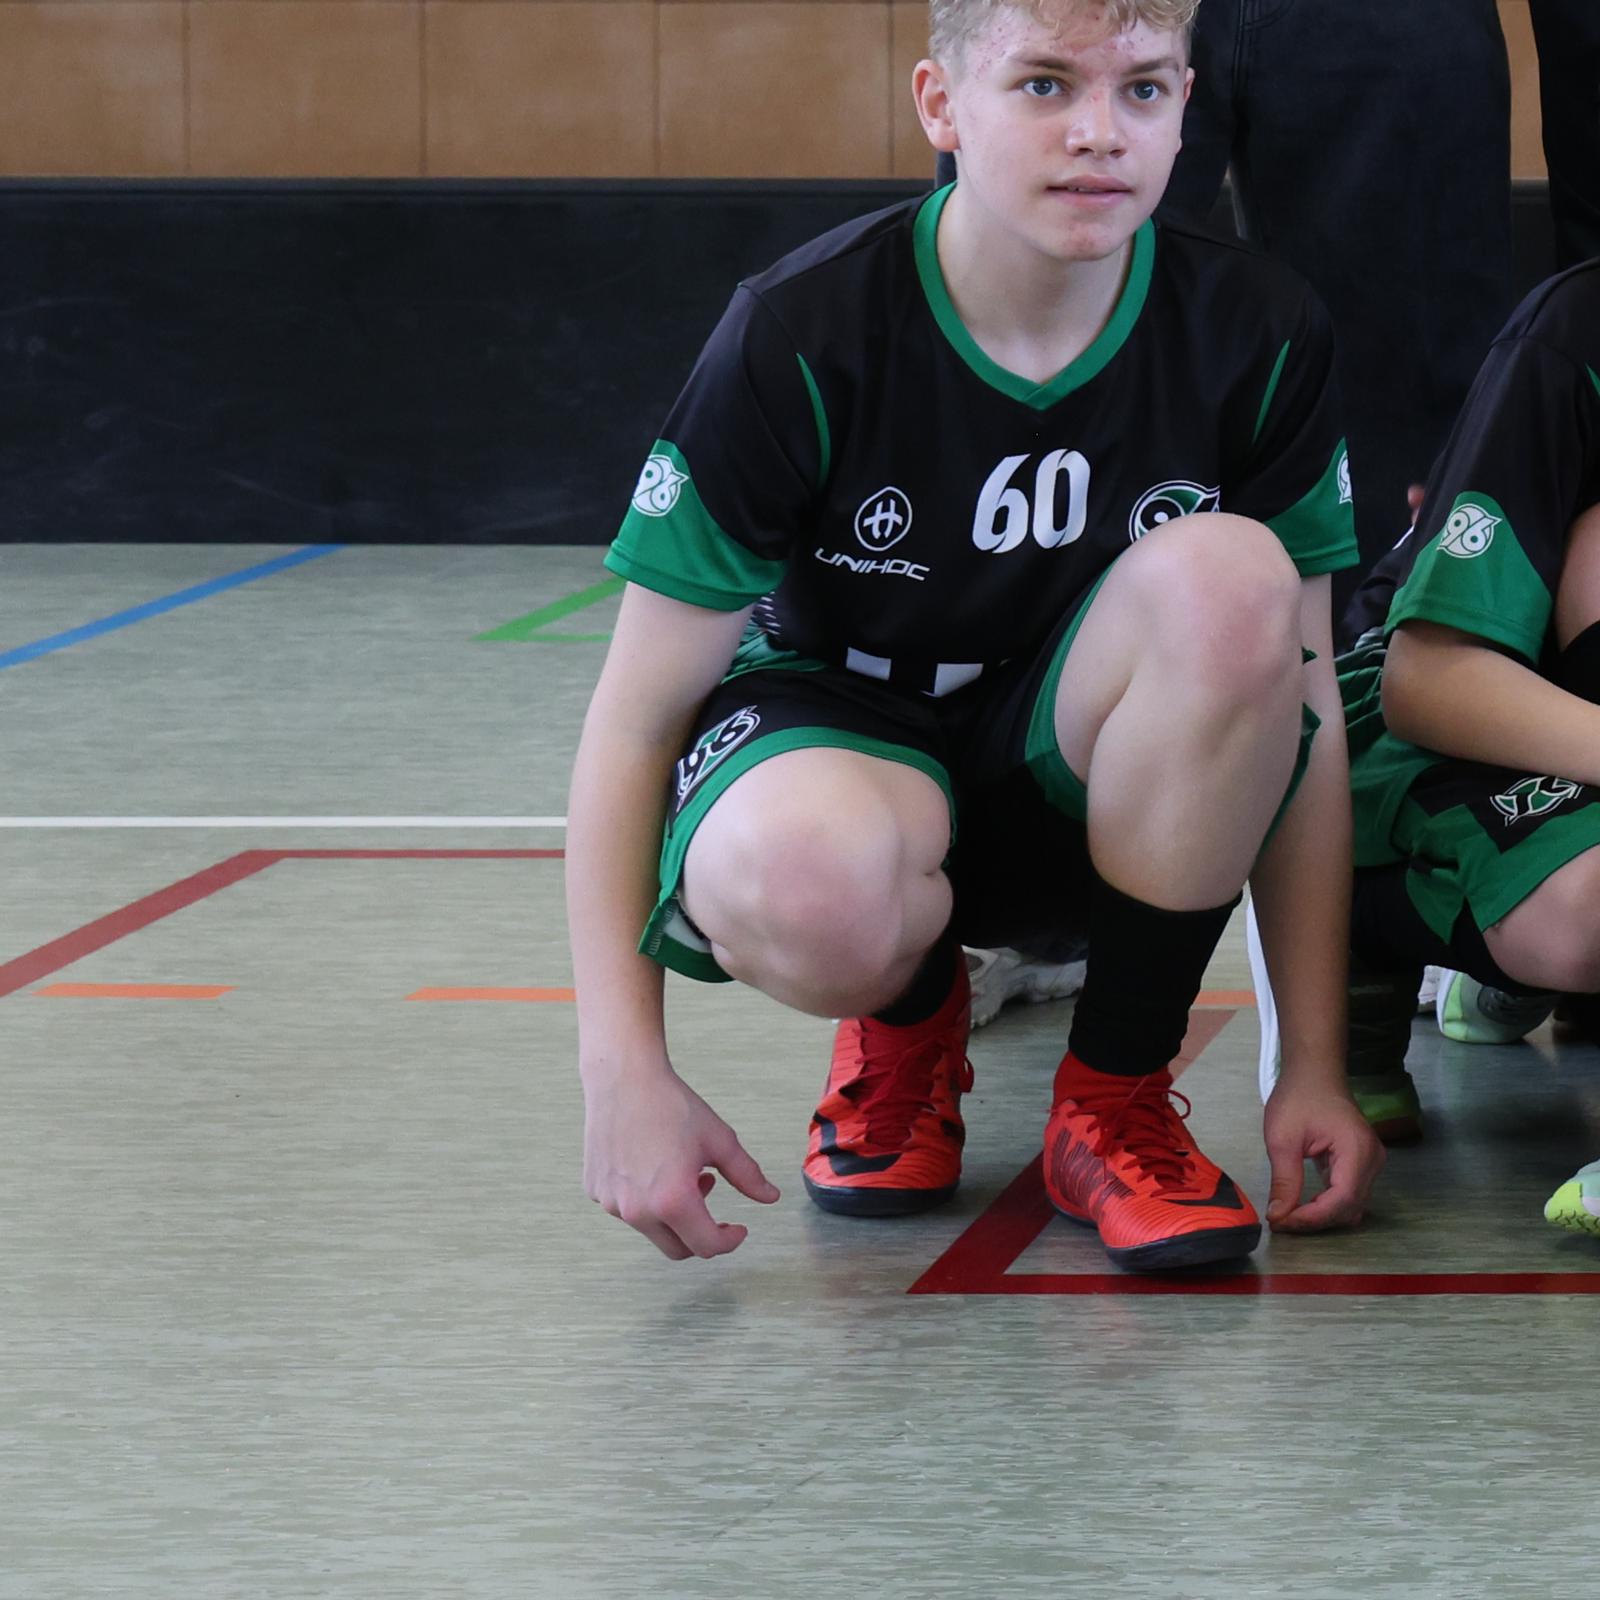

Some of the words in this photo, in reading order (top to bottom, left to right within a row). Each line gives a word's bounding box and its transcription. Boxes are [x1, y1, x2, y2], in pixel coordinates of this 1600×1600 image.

[632, 459, 684, 512] 96
[971, 448, 1091, 554] 60
[1440, 509, 1498, 553] 96
[814, 548, 930, 581] UNIHOC
